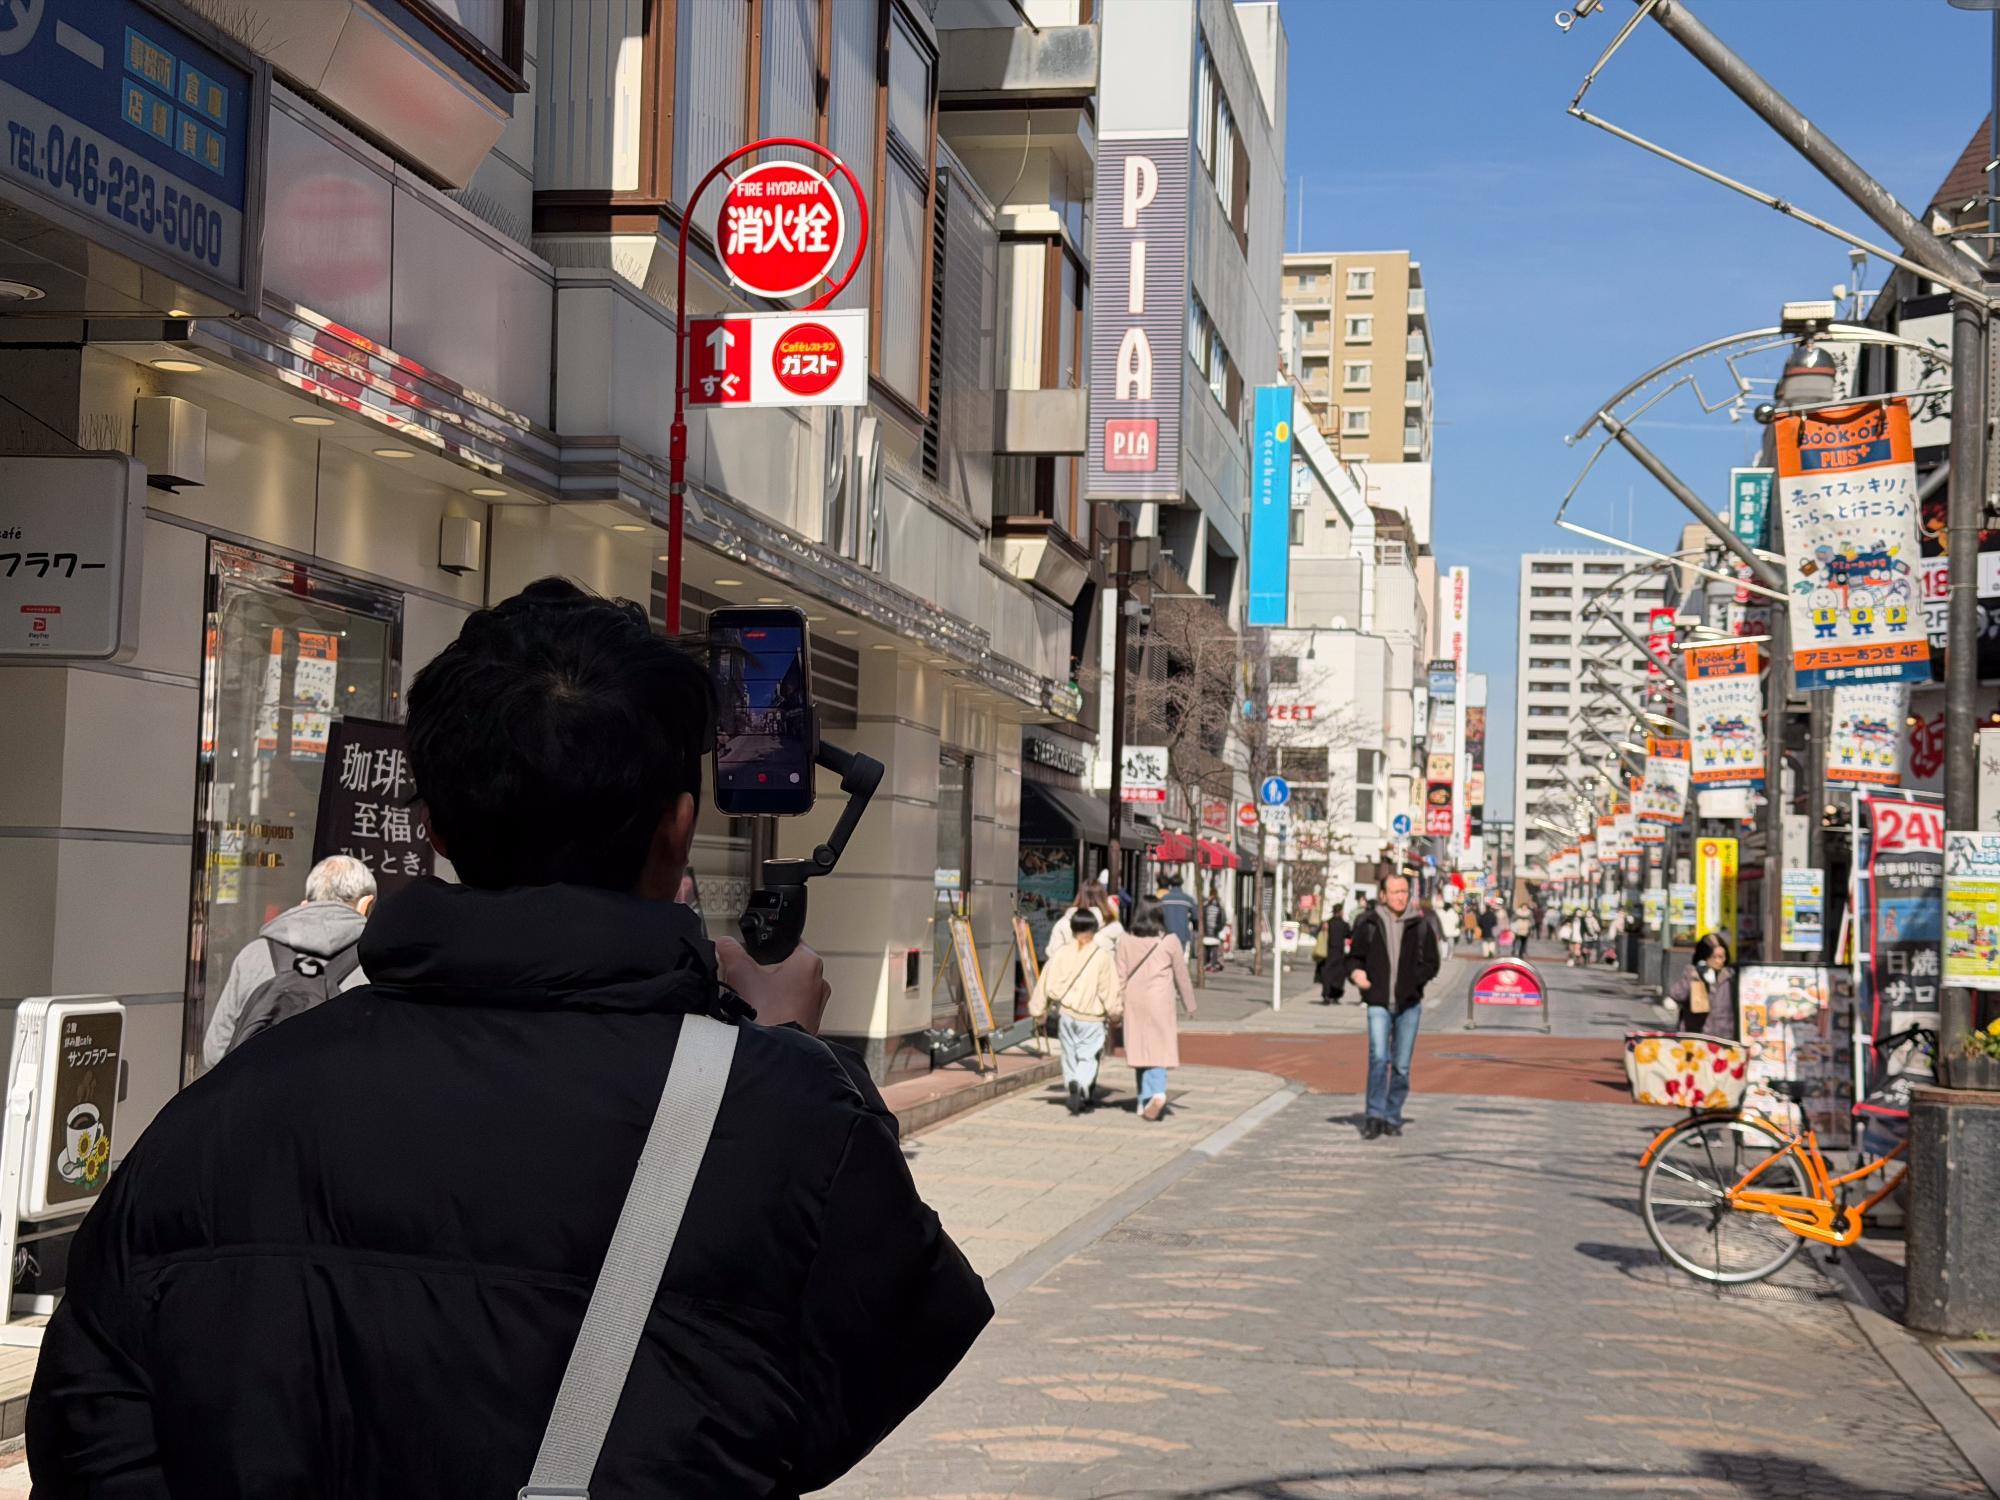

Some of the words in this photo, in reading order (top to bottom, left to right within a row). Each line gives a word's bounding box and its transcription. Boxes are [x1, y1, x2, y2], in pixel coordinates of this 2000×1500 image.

[8, 119, 222, 268] TEL:046-223-5000
[737, 182, 763, 197] FIRE
[766, 180, 821, 196] HYDRANT
[727, 202, 832, 255] 消火栓
[1115, 155, 1159, 400] PIA
[781, 354, 837, 376] ガスト
[700, 375, 740, 396] すぐ
[1113, 431, 1149, 454] PIA
[0, 552, 105, 578] フラワー
[67, 1048, 117, 1068] サンフラワー
